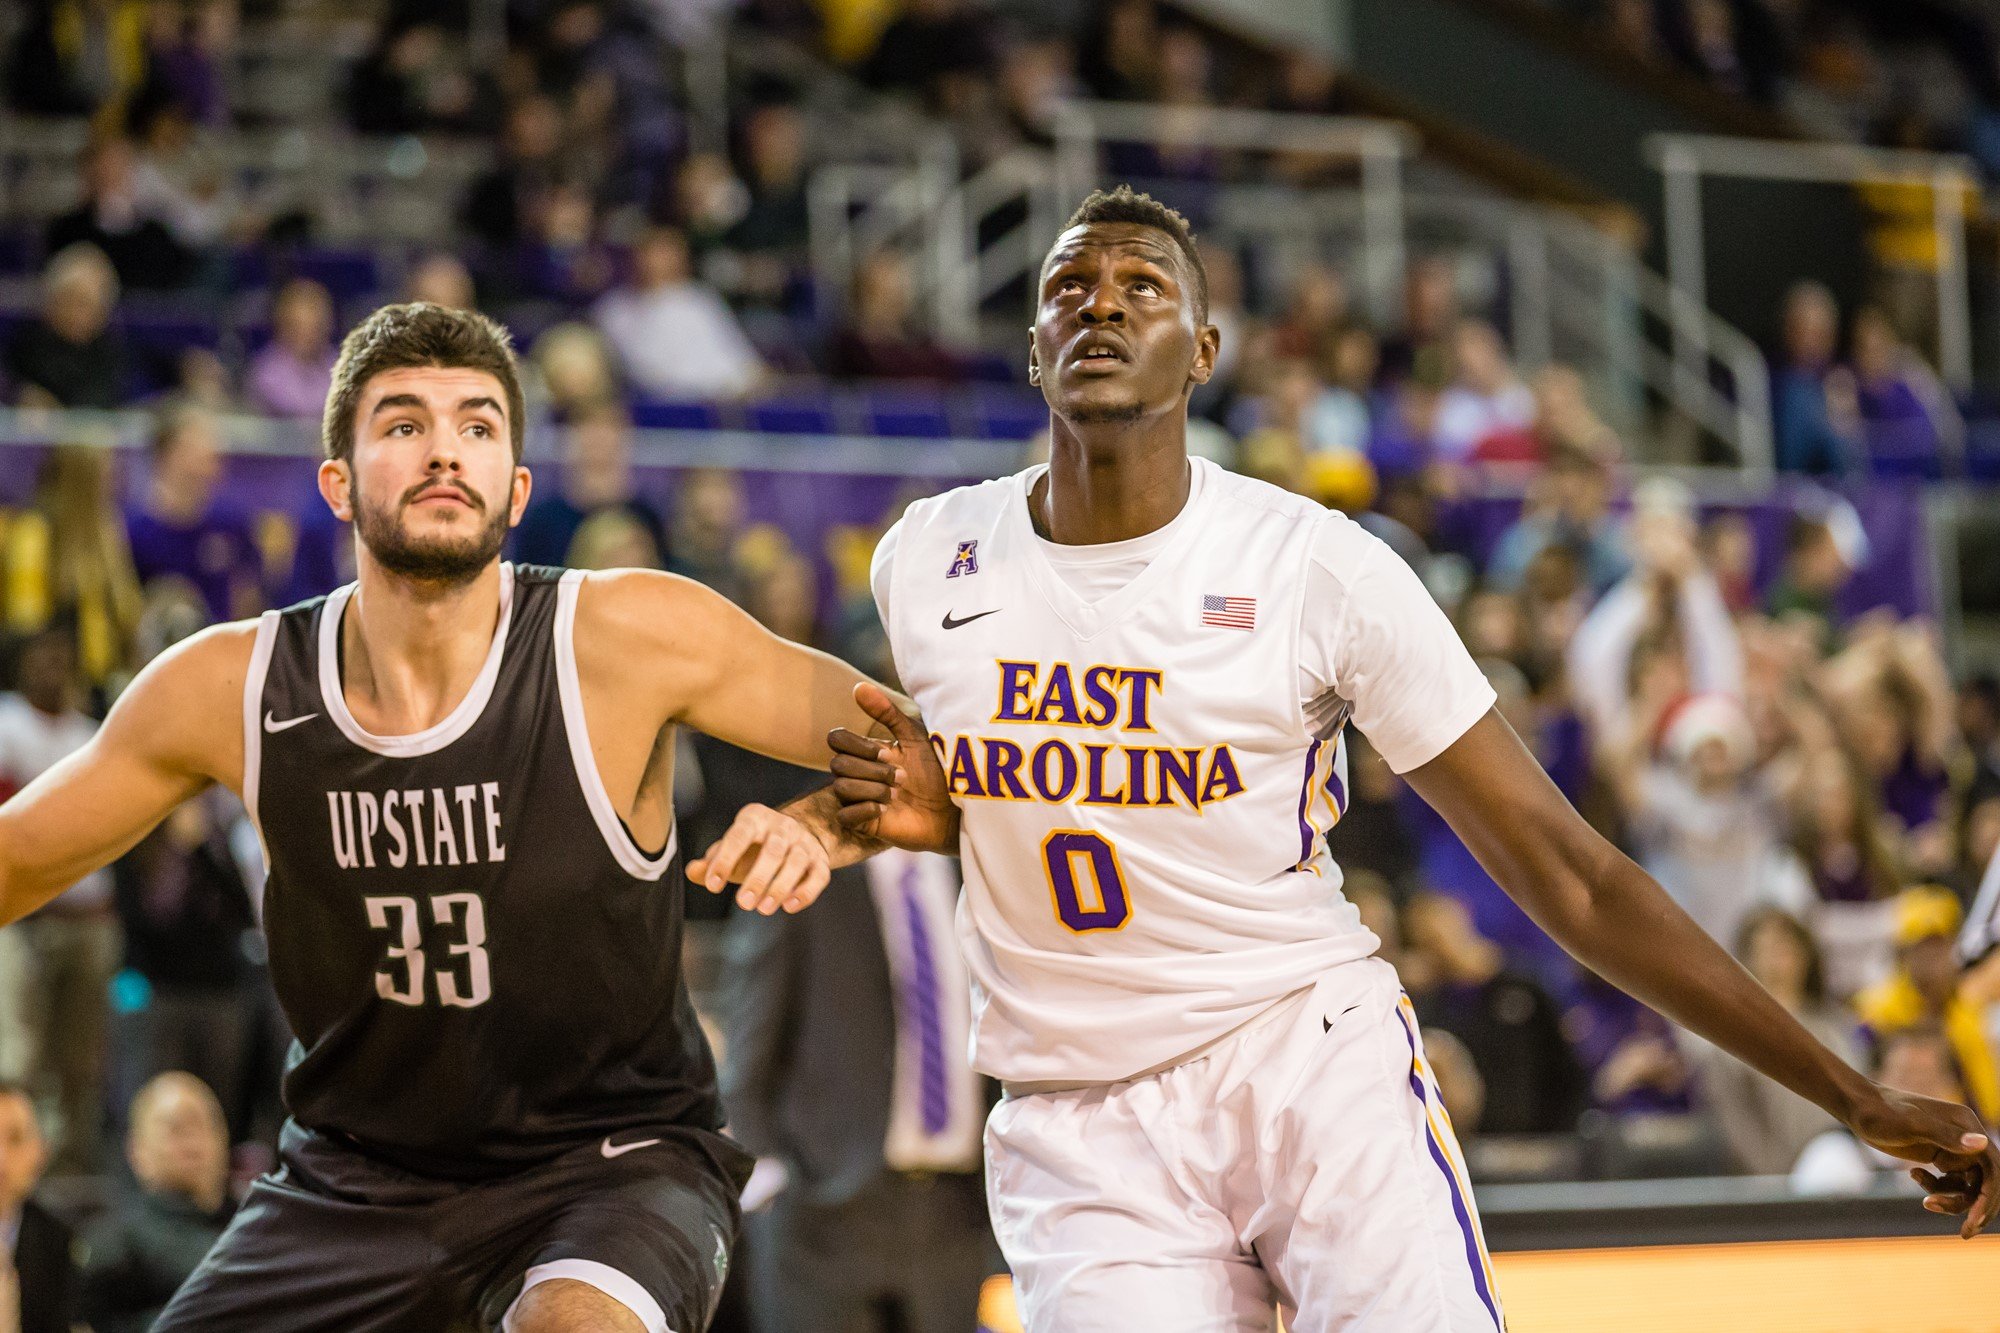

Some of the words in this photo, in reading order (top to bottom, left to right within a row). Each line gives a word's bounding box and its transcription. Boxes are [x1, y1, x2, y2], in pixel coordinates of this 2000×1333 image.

[946, 539, 978, 578] A
[990, 659, 1163, 734] EAST
[928, 731, 1247, 816] AROLINA
[326, 781, 506, 869] UPSTATE
[1040, 828, 1134, 936] 0
[364, 892, 492, 1008] 33
